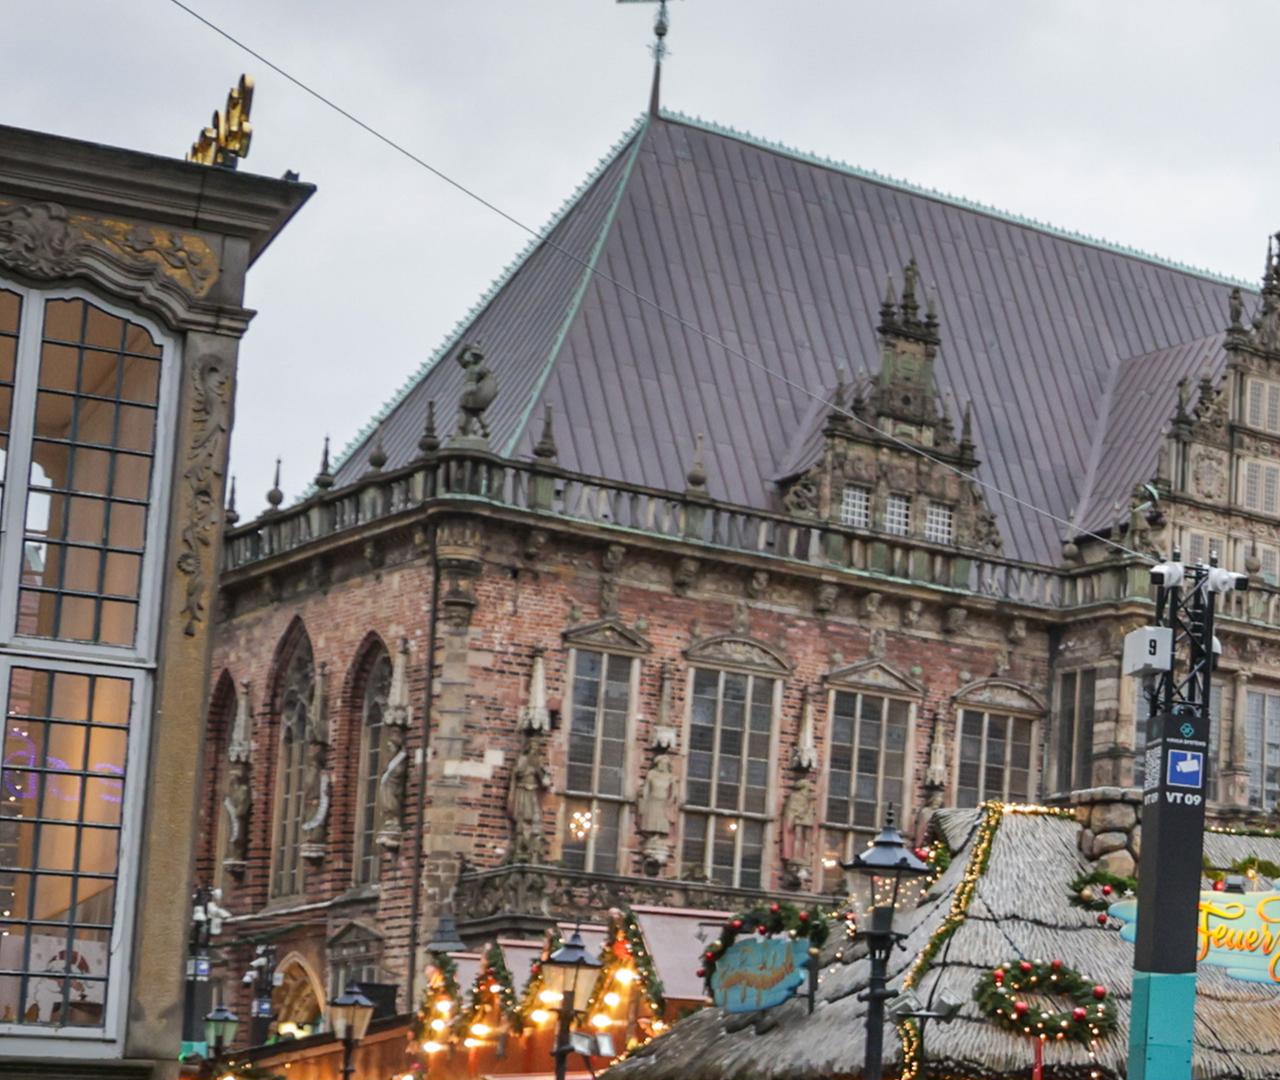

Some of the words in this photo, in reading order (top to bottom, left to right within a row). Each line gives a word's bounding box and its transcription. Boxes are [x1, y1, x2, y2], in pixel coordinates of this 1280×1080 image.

[1148, 639, 1157, 656] 9
[1166, 791, 1184, 805] VT
[1184, 792, 1202, 806] 09
